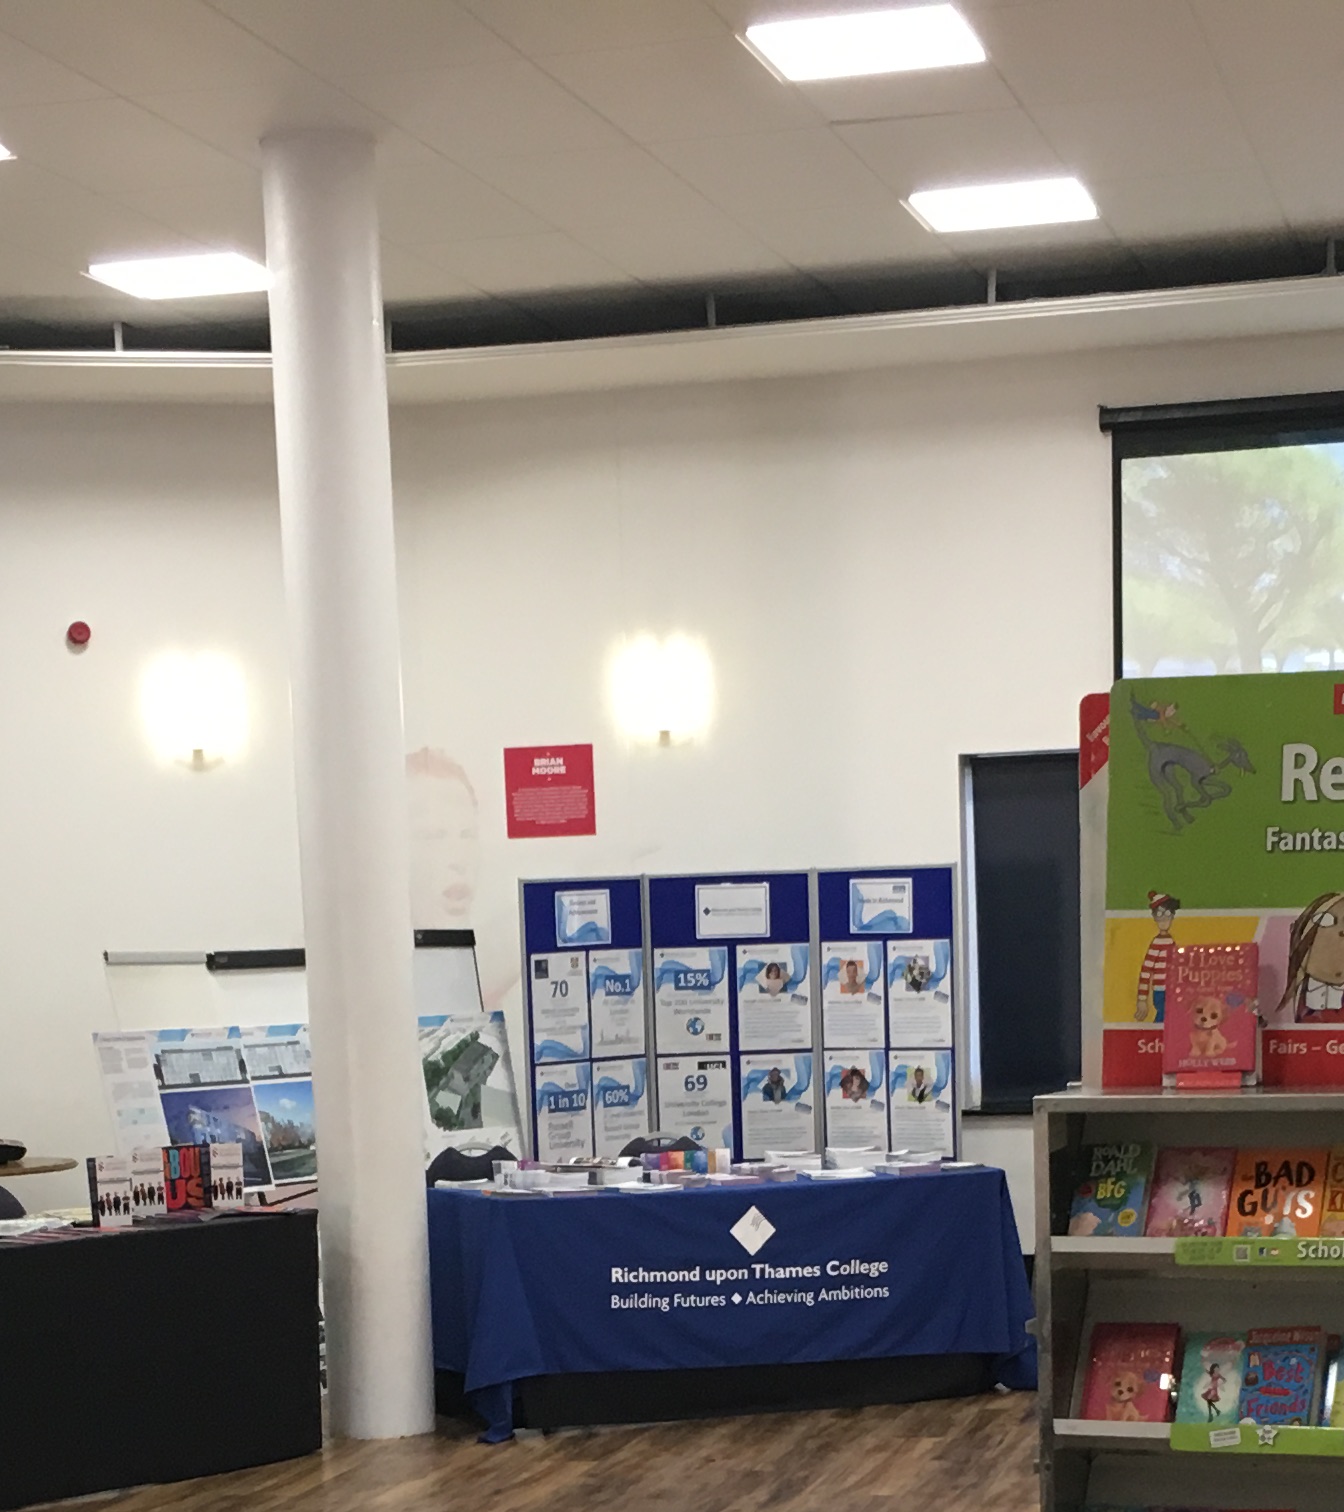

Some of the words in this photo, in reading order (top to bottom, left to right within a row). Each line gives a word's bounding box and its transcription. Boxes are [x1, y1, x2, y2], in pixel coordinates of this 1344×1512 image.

[1188, 953, 1197, 967] I
[1199, 952, 1236, 967] Love
[677, 972, 710, 988] 15%
[1178, 965, 1244, 987] Puppies
[550, 980, 569, 998] 70
[605, 979, 632, 993] No.1
[1268, 1039, 1308, 1055] Fairs
[683, 1074, 709, 1092] 69
[549, 1095, 555, 1109] 1
[558, 1094, 570, 1108] in
[571, 1092, 586, 1107] 10
[605, 1089, 629, 1104] 60%
[1093, 1144, 1142, 1159] ROALD
[1090, 1157, 1140, 1177] DAHL
[1255, 1160, 1316, 1188] BAD
[1096, 1177, 1126, 1200] BFG
[1237, 1188, 1314, 1219] GUYS
[611, 1267, 701, 1284] Richmond
[705, 1269, 748, 1285] upon
[751, 1263, 821, 1280] Thames
[826, 1259, 889, 1277] College
[611, 1293, 670, 1312] Building
[674, 1293, 726, 1308] Futures
[745, 1289, 815, 1306] Achieving
[817, 1285, 890, 1301] Ambitions
[1262, 1360, 1305, 1384] Best
